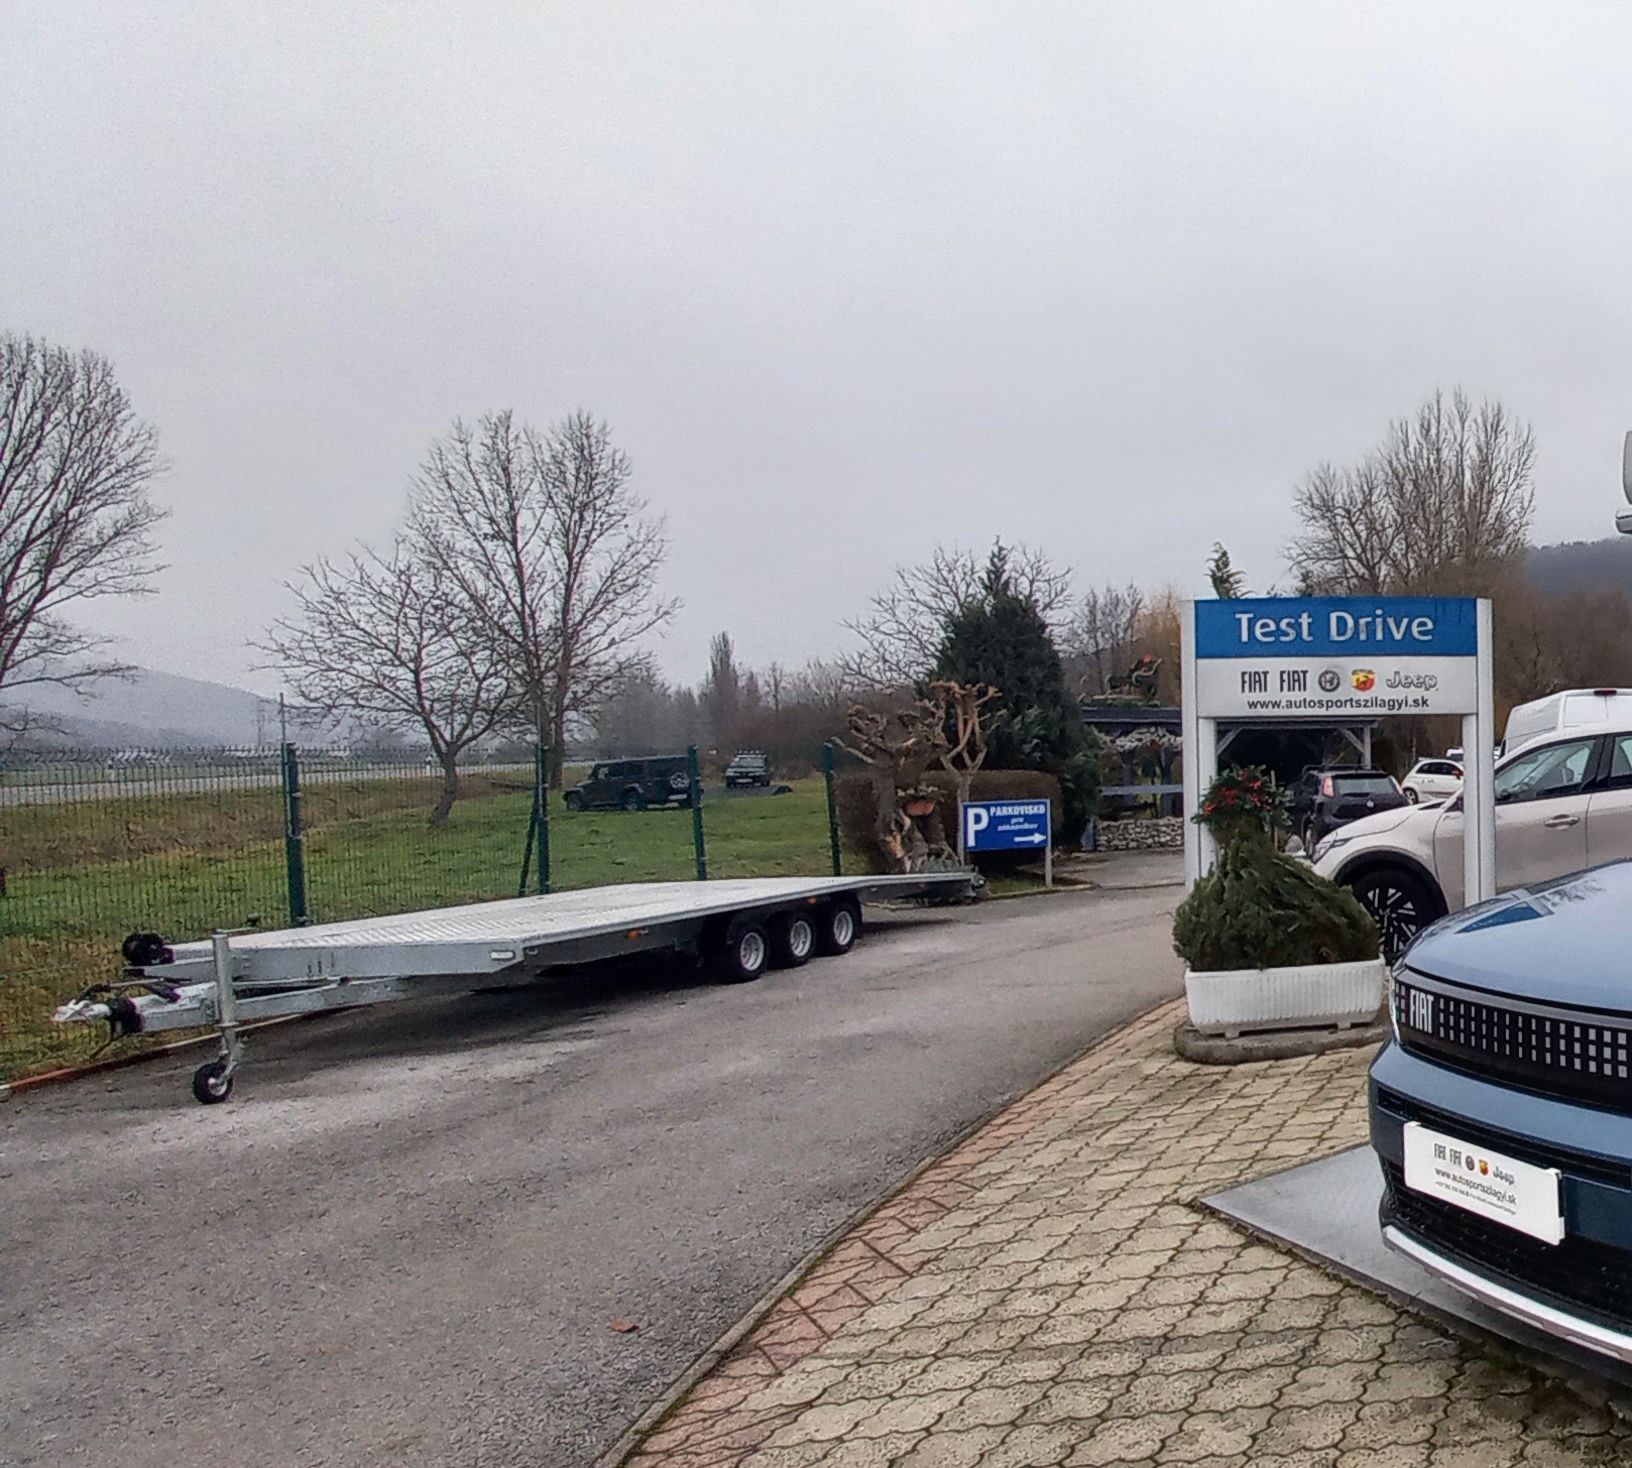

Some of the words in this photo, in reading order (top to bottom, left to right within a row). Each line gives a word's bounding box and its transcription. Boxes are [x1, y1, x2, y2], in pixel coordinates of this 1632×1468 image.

[1235, 611, 1314, 643] Test
[1329, 608, 1434, 642] Drive
[1240, 670, 1270, 694] FIAT
[1279, 669, 1309, 693] FIAT
[1386, 670, 1438, 691] Jeep
[1247, 696, 1430, 711] www.autosportszilagyi.sk
[990, 804, 1046, 817] PARKOVISKO
[967, 807, 989, 847] P
[1409, 988, 1434, 1034] FIAT
